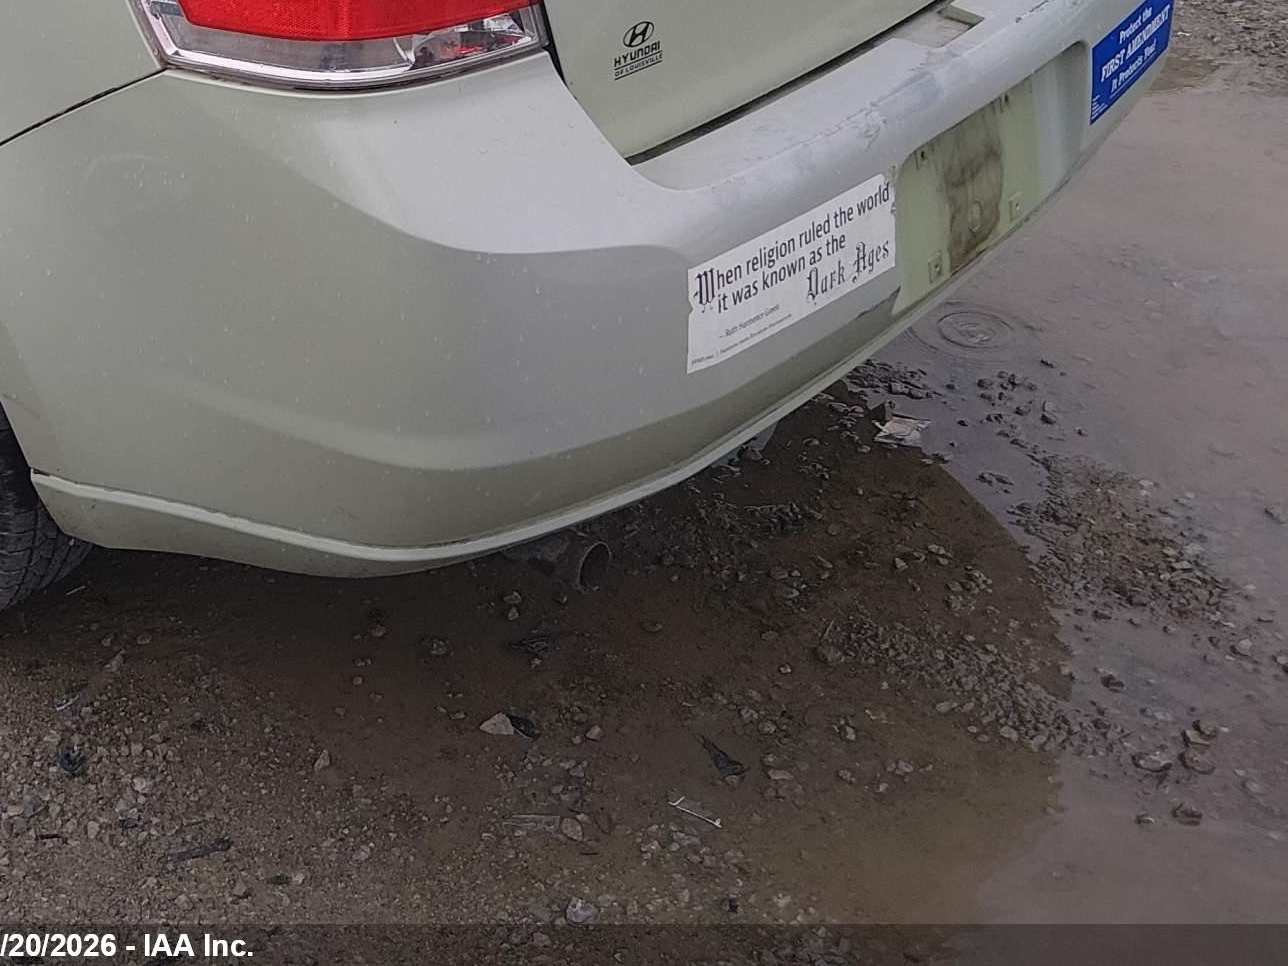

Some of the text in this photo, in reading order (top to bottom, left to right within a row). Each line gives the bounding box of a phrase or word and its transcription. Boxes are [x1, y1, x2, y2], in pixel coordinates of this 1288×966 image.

[1101, 4, 1171, 82] FIRST AMENDMENT
[1142, 6, 1153, 23] the
[614, 40, 661, 67] HYUNDAI
[614, 53, 663, 77] OF LOUISVILLE
[693, 182, 890, 313] When religion ruled the world
[717, 234, 846, 314] it was known as the
[807, 240, 889, 305] Dark Ages
